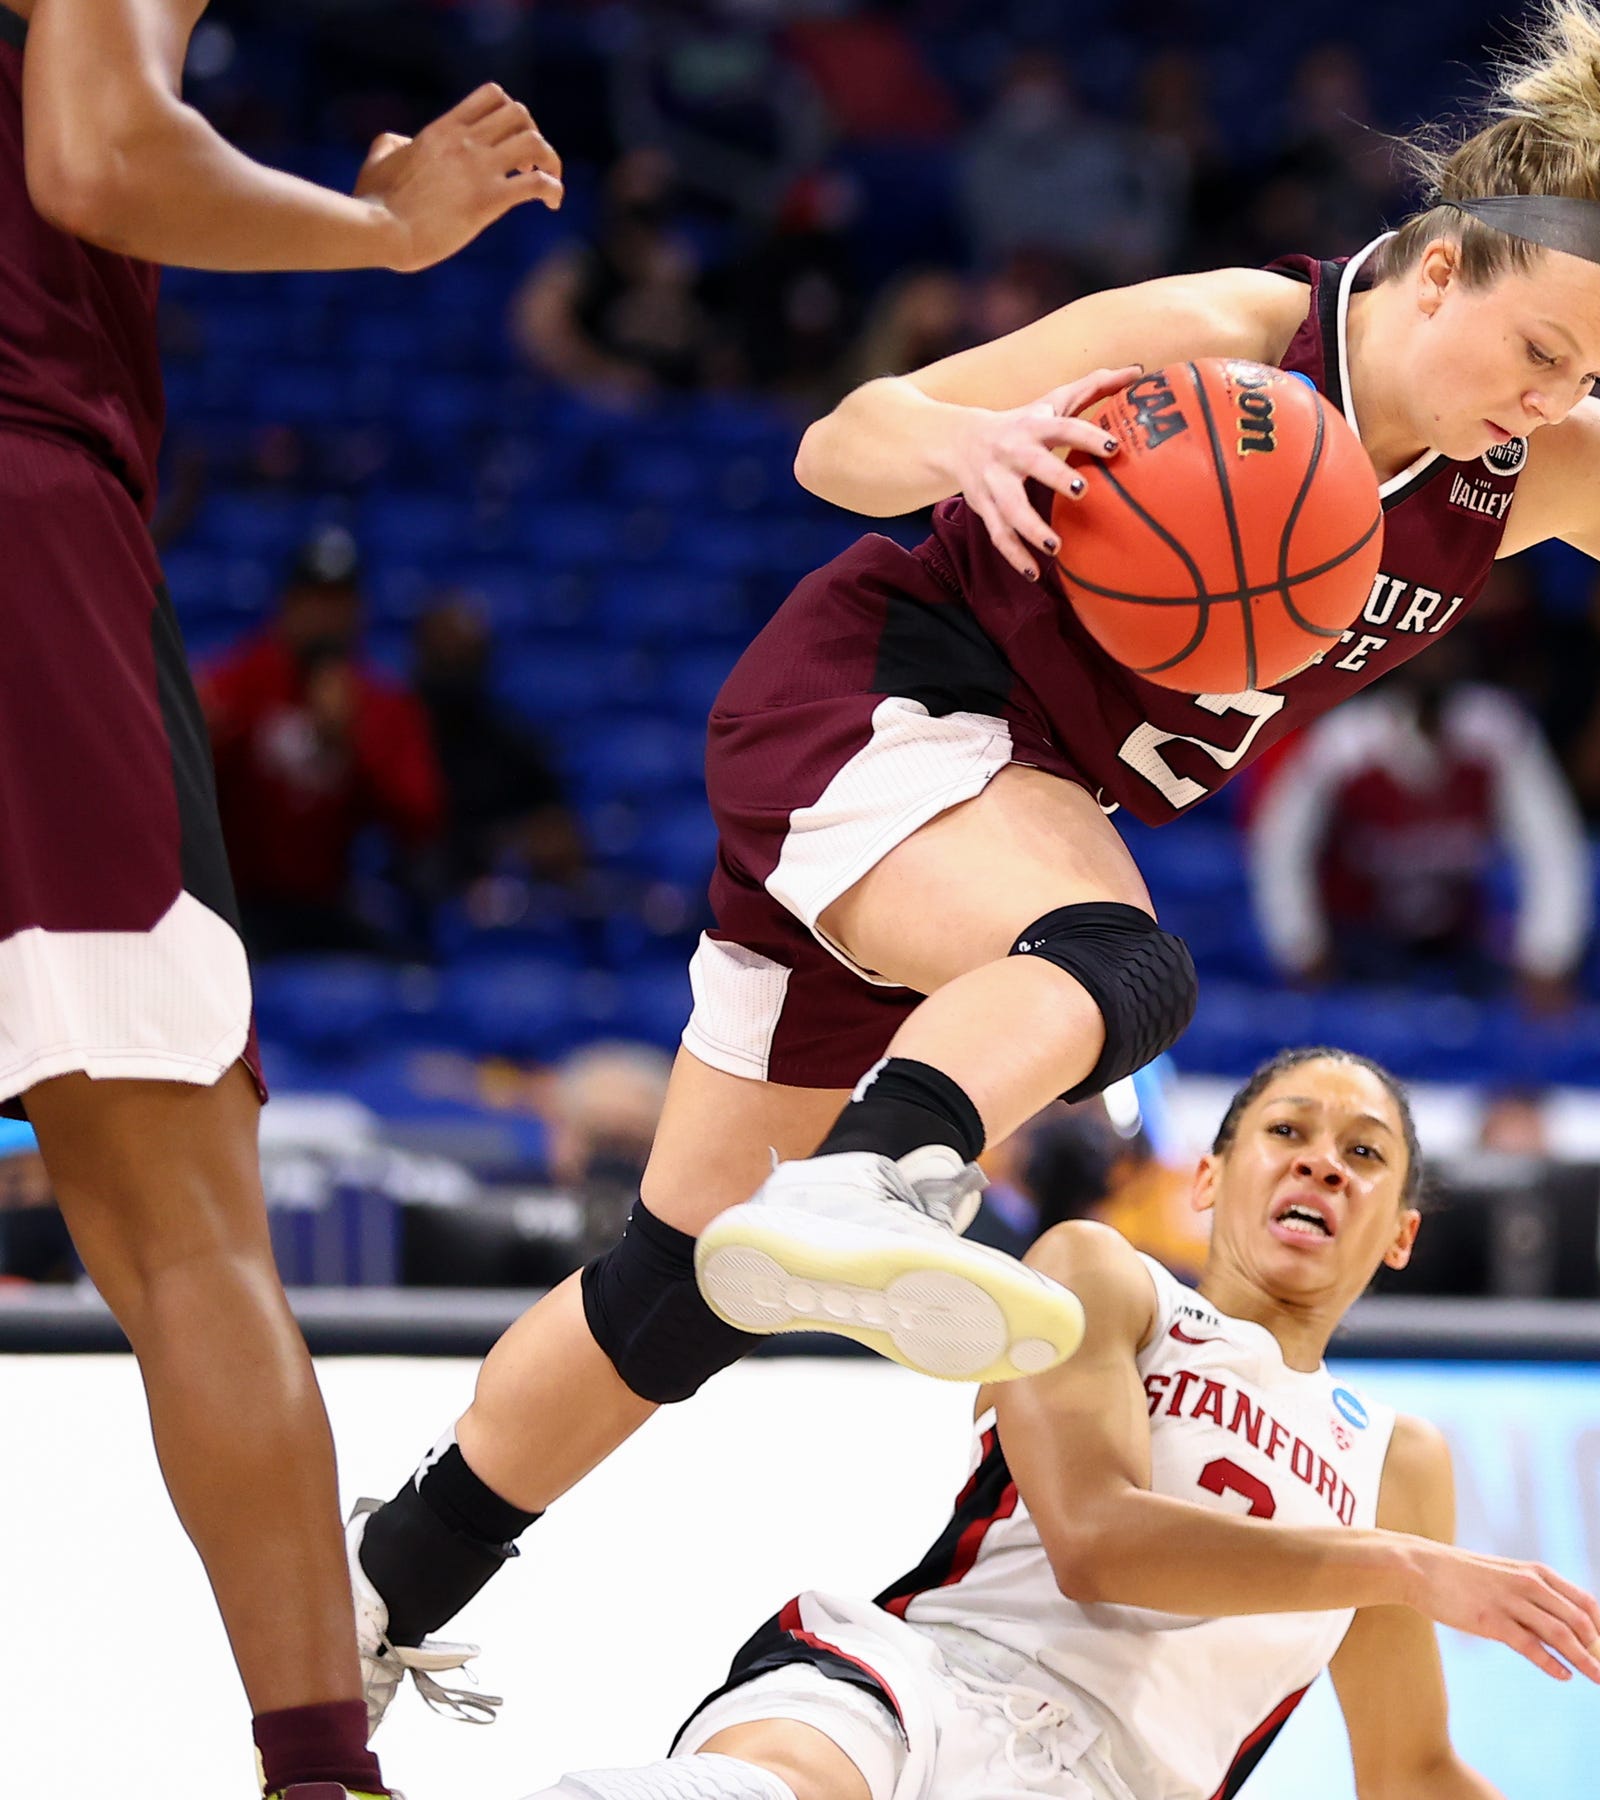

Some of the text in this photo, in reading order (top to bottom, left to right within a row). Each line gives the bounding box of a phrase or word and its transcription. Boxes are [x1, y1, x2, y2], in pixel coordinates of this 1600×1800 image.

[1126, 370, 1189, 450] CAA
[1488, 445, 1520, 465] UNITE
[1448, 471, 1514, 520] VALLEY
[1362, 572, 1464, 633] URI
[1143, 1370, 1357, 1527] STANFORD
